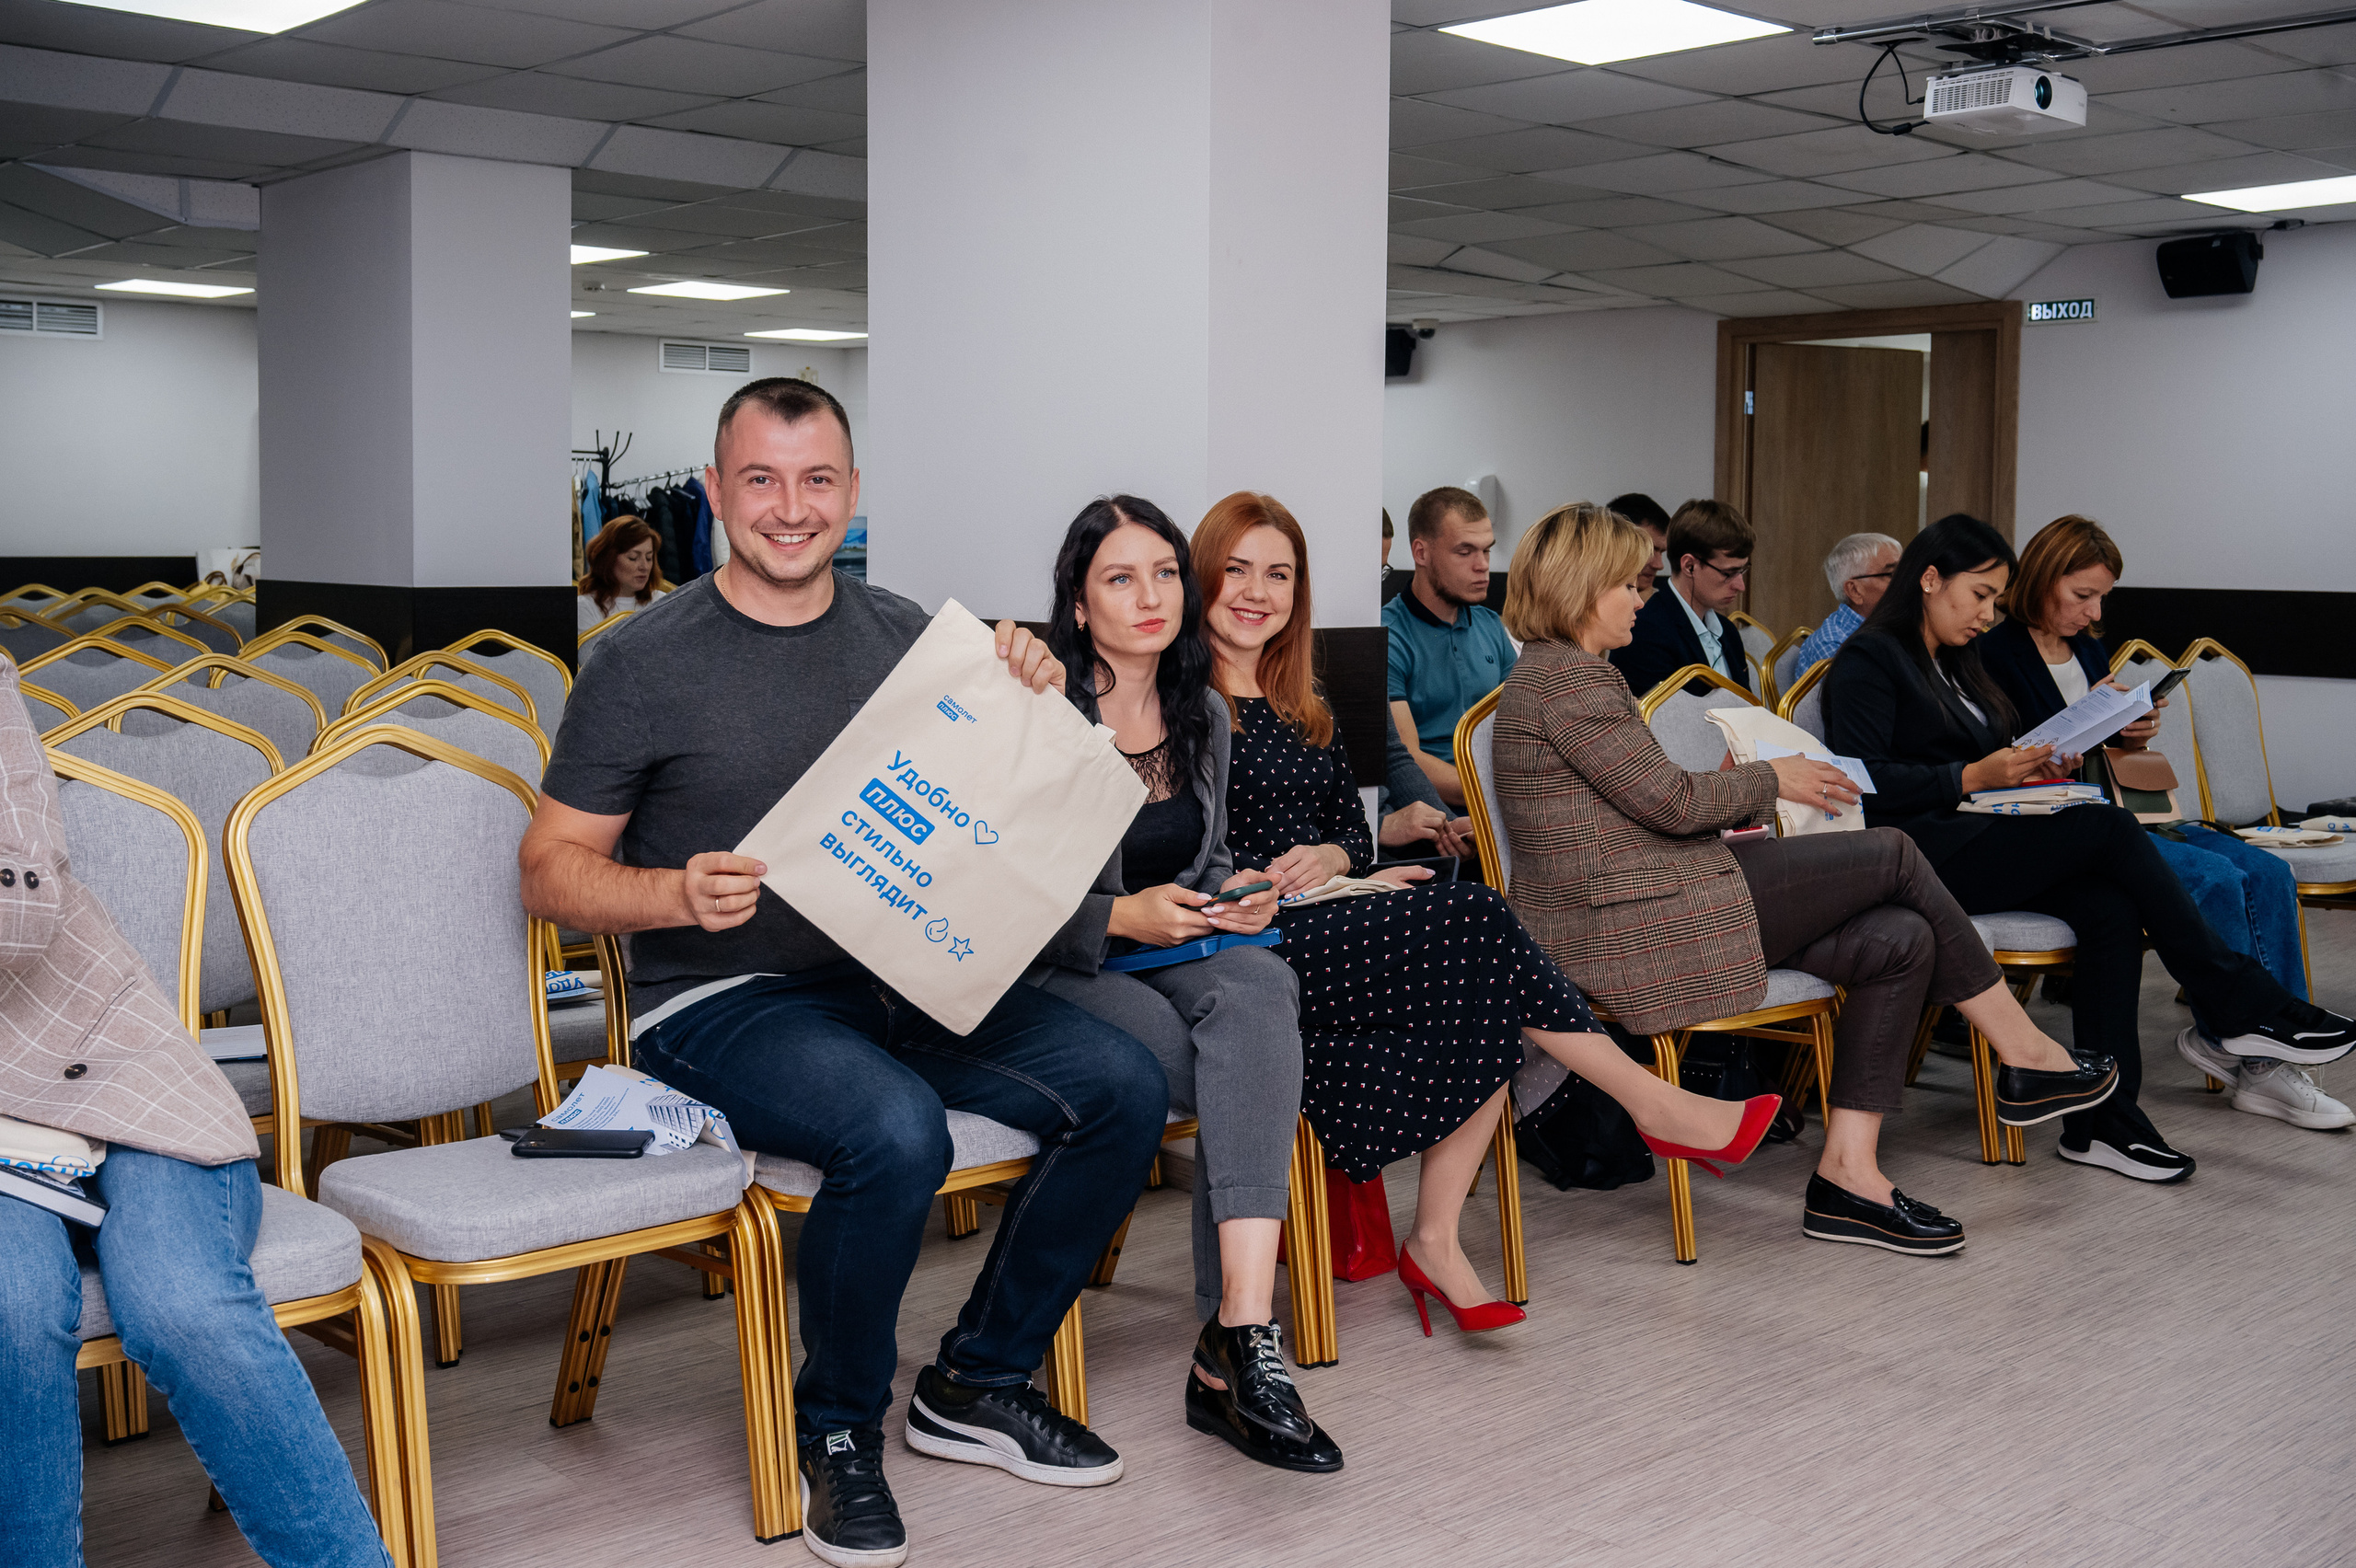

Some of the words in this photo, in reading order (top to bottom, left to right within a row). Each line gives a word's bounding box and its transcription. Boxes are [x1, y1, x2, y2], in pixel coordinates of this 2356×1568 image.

[2031, 301, 2092, 321] ВЫХОД
[943, 695, 977, 724] самолет
[886, 750, 970, 828] Удобно
[841, 811, 933, 888] стильно
[819, 832, 929, 921] выглядит
[551, 1092, 584, 1122] самолет
